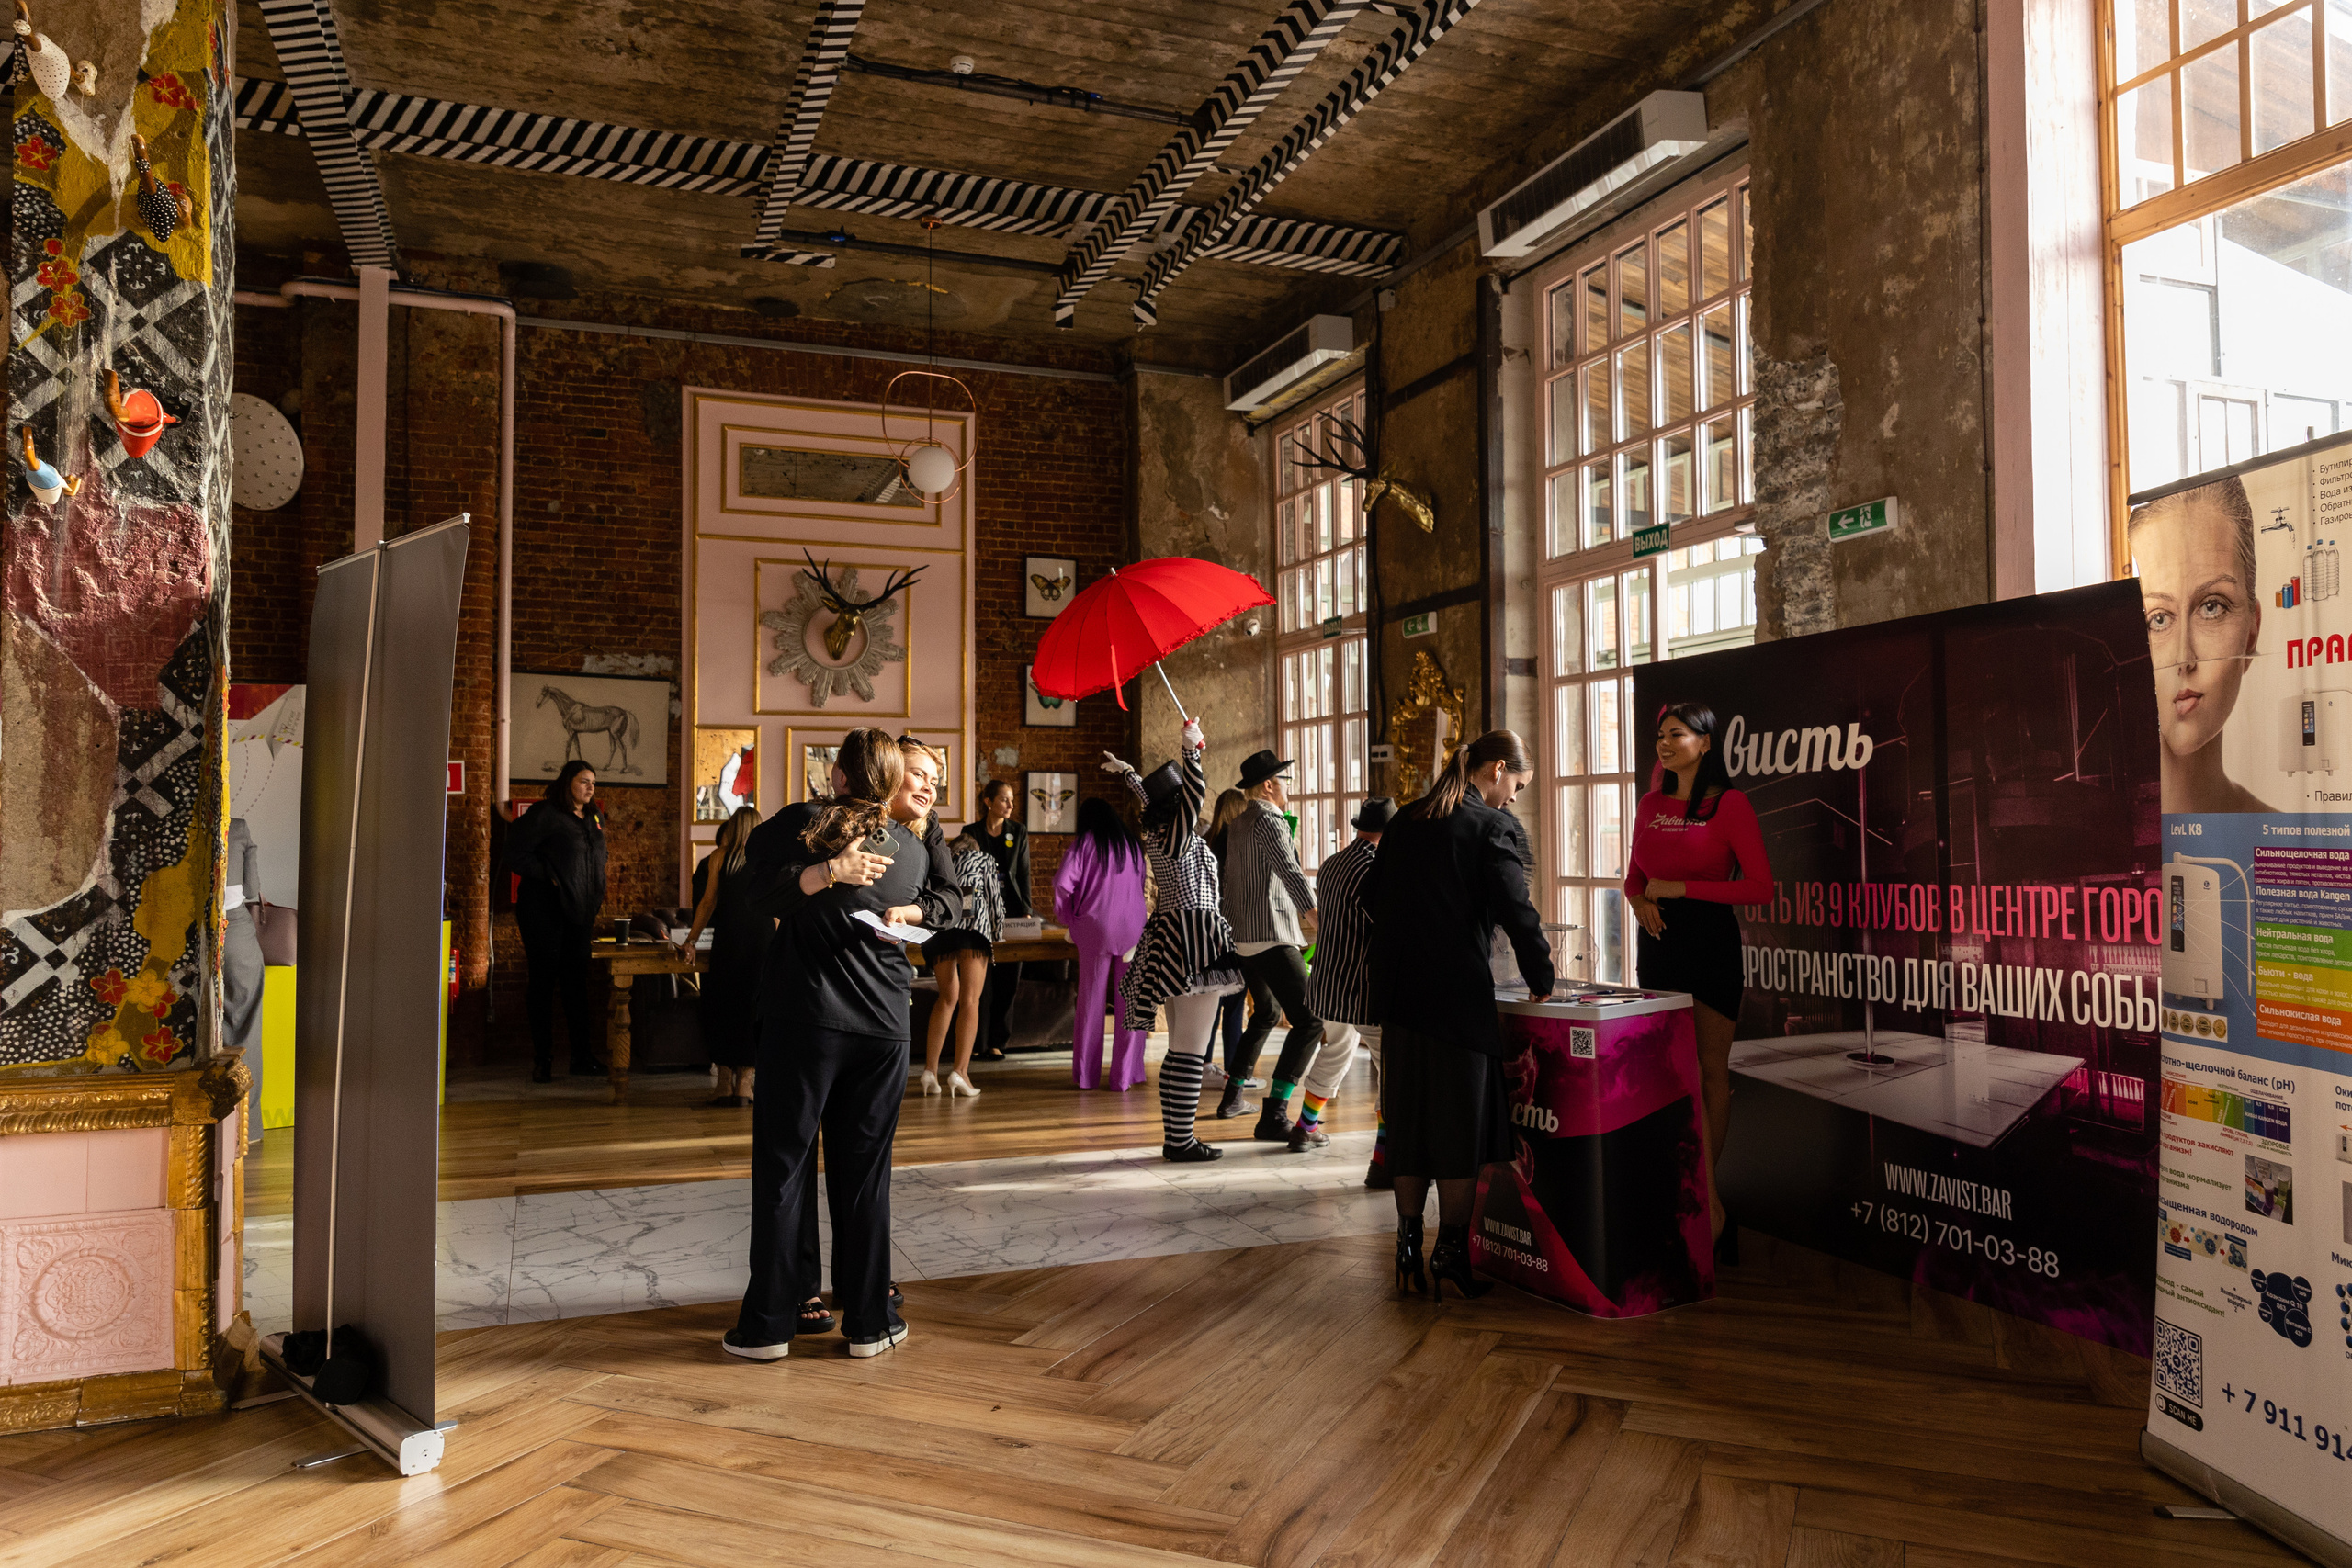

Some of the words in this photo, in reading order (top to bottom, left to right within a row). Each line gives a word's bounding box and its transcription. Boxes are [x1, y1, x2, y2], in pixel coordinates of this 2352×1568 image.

[2320, 489, 2341, 499] Вода
[1634, 529, 1668, 552] ВЫХОД
[2287, 633, 2352, 669] ПРА
[2262, 824, 2268, 835] 5
[2270, 827, 2301, 836] типов
[2304, 824, 2350, 836] полезной
[2255, 848, 2327, 860] Сильнощелочная
[2329, 852, 2350, 861] вода
[2256, 886, 2297, 897] Полезная
[2299, 890, 2319, 899] вода
[2320, 889, 2350, 902] Kangen
[1795, 881, 1825, 927] ИЗ
[1829, 882, 1843, 928] 9
[1848, 882, 1942, 932] КЛУБОВ
[1949, 884, 1965, 934] В
[1971, 885, 2076, 942] ЦЕНТРЕ
[2083, 886, 2163, 945] ГОРО
[2256, 927, 2312, 942] Нейтральная
[2313, 935, 2334, 944] вода
[2257, 965, 2285, 977] Бьюти
[2293, 972, 2313, 982] вода
[1903, 957, 1956, 1013] ДЛЯ
[1962, 962, 2065, 1023] ВАШИХ
[2071, 970, 2162, 1034] СОБЫ
[2259, 1004, 2320, 1022] Сильнокислая
[2322, 1015, 2342, 1026] вода
[2237, 1070, 2268, 1086] баланс
[2271, 1077, 2295, 1094] (pH)
[1509, 1100, 1559, 1133] сть
[2335, 1101, 2352, 1111] пот
[2197, 1142, 2234, 1156] закисляют
[2261, 1139, 2290, 1151] ЗДОРОВЬЕ
[1884, 1162, 2013, 1221] WWW.ZAVIST.BAR
[2187, 1173, 2232, 1191] нормализует
[1483, 1216, 1532, 1247] WWW.ZAVIST.BAR
[2210, 1213, 2258, 1237] водородом
[1850, 1201, 1873, 1224] +7
[1880, 1203, 1928, 1244] (812)
[1935, 1220, 2060, 1278] 701-03-88
[1472, 1235, 1481, 1247] +7
[1482, 1238, 1501, 1257] (812)
[1502, 1246, 1548, 1272] 701-03-88
[2180, 1284, 2204, 1298] самый
[2177, 1292, 2225, 1317] антиоксидант!
[2168, 1404, 2186, 1420] SCAN
[2187, 1412, 2197, 1426] ME
[2244, 1389, 2256, 1413] 7
[2263, 1400, 2307, 1441] 911
